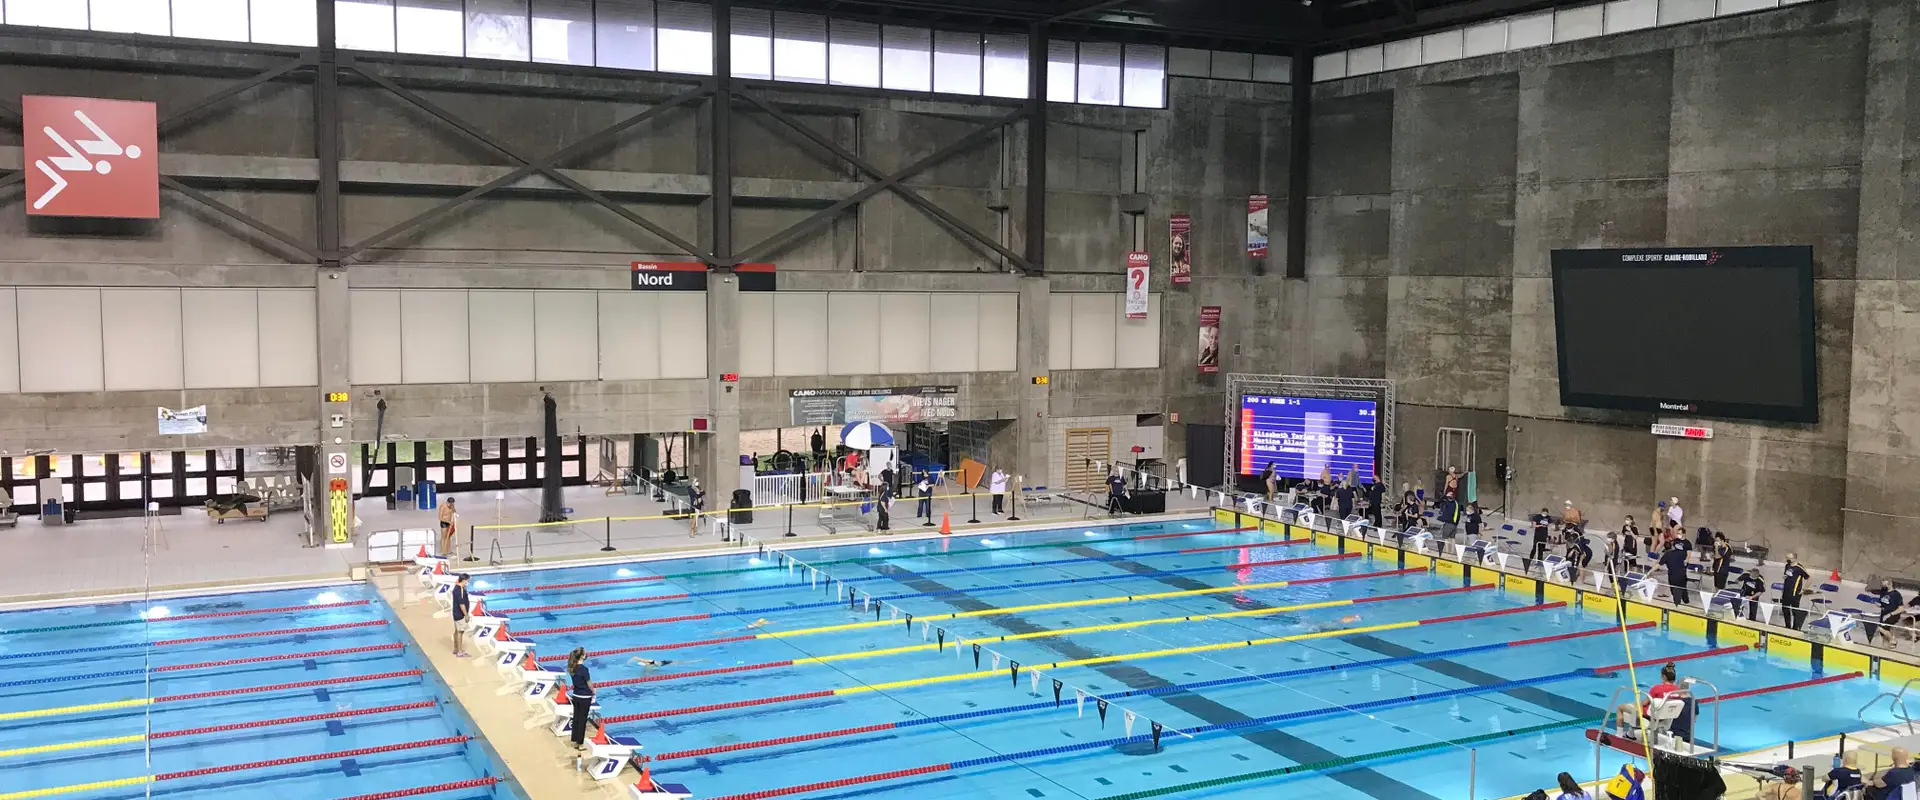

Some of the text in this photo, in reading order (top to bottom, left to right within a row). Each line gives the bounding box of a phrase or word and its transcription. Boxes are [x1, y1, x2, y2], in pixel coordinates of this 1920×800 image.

[1664, 253, 1707, 261] CLAUDE-ROBILLARD
[638, 272, 673, 286] Nord
[330, 392, 348, 402] 0:38
[912, 396, 955, 407] VIENS NAGER
[1660, 402, 1689, 411] Montréal
[920, 407, 955, 417] AVEC NOUS
[1507, 577, 1523, 585] OMEGA
[1584, 594, 1602, 603] OMEGA
[1769, 637, 1792, 646] OMEGA
